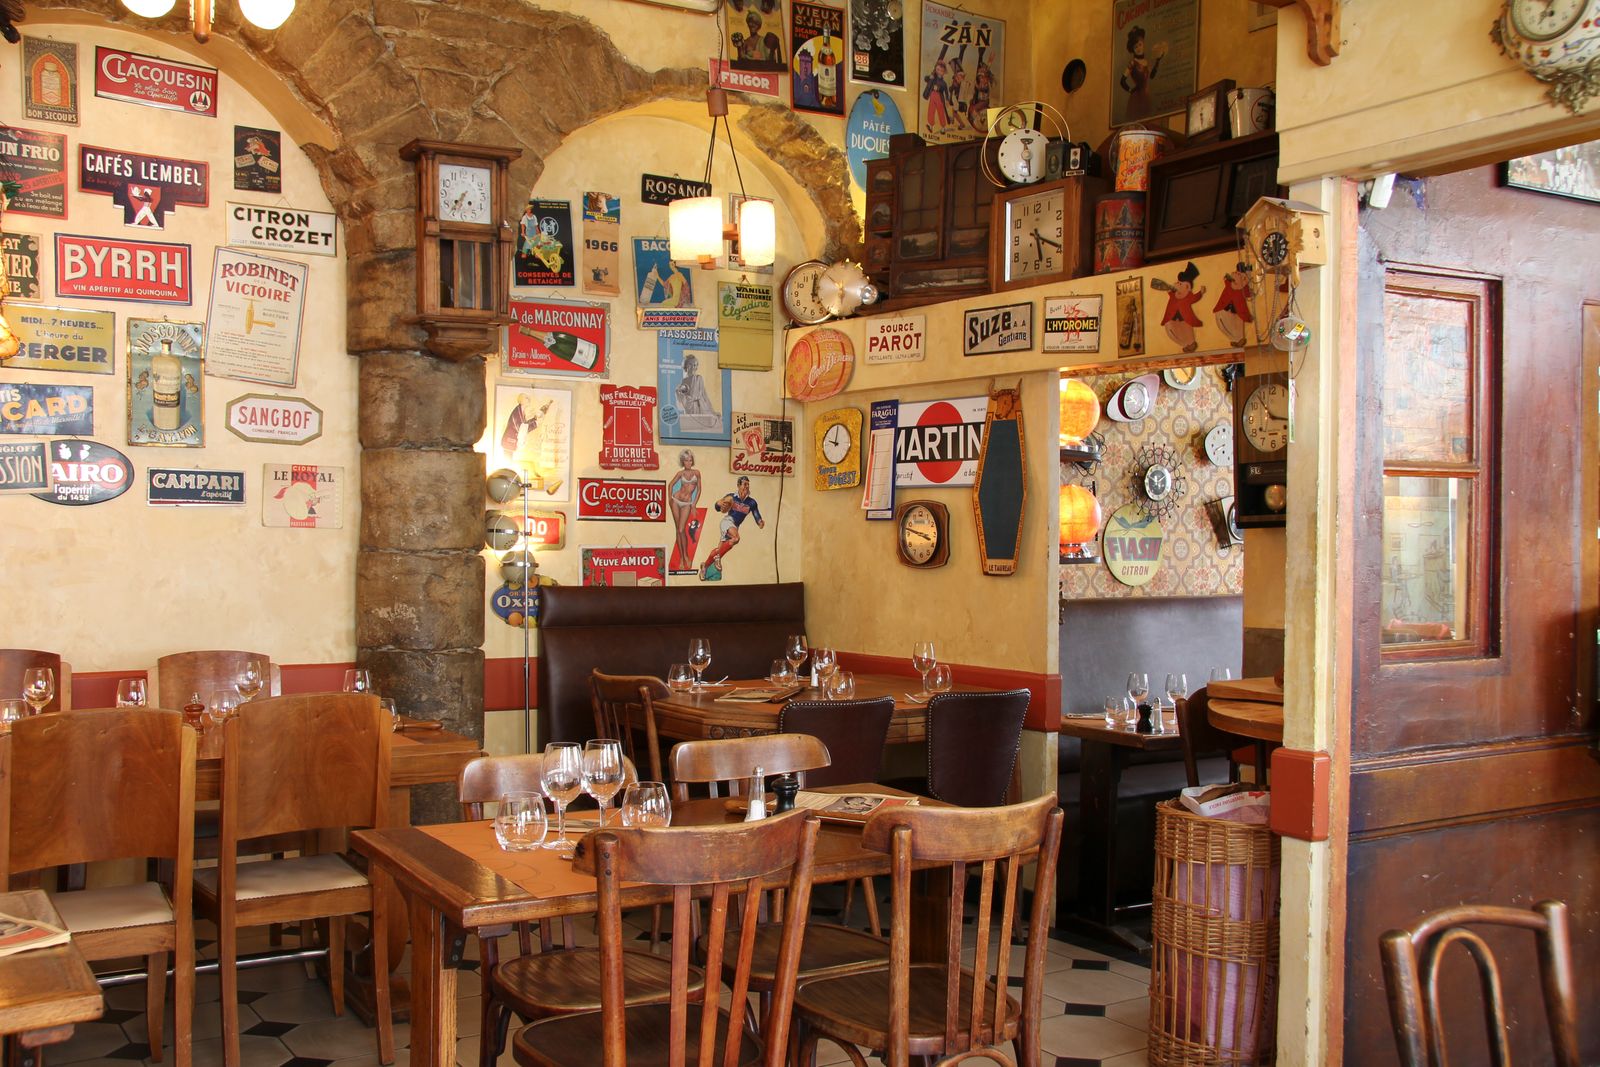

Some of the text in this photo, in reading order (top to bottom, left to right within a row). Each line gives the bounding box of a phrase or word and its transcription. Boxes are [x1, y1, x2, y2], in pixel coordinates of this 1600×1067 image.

[796, 5, 839, 21] VIEUX
[940, 24, 992, 47] ZAN
[102, 54, 212, 92] CLACQUESIN
[721, 72, 770, 89] FRIGOR
[863, 119, 892, 135] PÂTÉE
[21, 143, 60, 161] FRIO
[86, 153, 133, 178] CAFÉS
[141, 161, 203, 187] LEMBEL
[1033, 202, 1041, 213] 12
[233, 206, 310, 228] CITRON
[1014, 219, 1022, 229] 10
[251, 225, 333, 246] CROZET
[585, 239, 618, 252] 1966
[63, 243, 183, 289] BYRRH
[220, 261, 299, 293] ROBINET
[518, 271, 559, 279] CONSERVES
[123, 287, 134, 295] AU
[135, 288, 178, 298] QUINQUINA
[225, 279, 292, 303] VICTOIRE
[736, 286, 770, 295] VANILLE
[1116, 281, 1140, 296] SUZE
[52, 318, 57, 326] 7
[534, 309, 604, 329] MARCONNAY
[1046, 319, 1098, 332] L'HYDROMEL
[659, 329, 714, 342] MASSOSEIN
[880, 322, 914, 334] SOURCE
[969, 310, 1012, 350] Suze
[869, 333, 922, 353] PAROT
[998, 330, 1027, 347] Gentiane
[18, 341, 108, 365] BERGER
[238, 405, 313, 431] SANGBOF
[737, 413, 747, 424] ici
[613, 448, 651, 459] DUCRUET
[153, 473, 240, 491] CAMPARI
[274, 470, 335, 483] LE ROYAL
[828, 471, 857, 486] DIGEST
[582, 481, 663, 506] CLACQUESIN
[1105, 536, 1163, 562] FLASH
[592, 556, 655, 567] VEUVE AMIOT
[1121, 565, 1150, 576] CITRON
